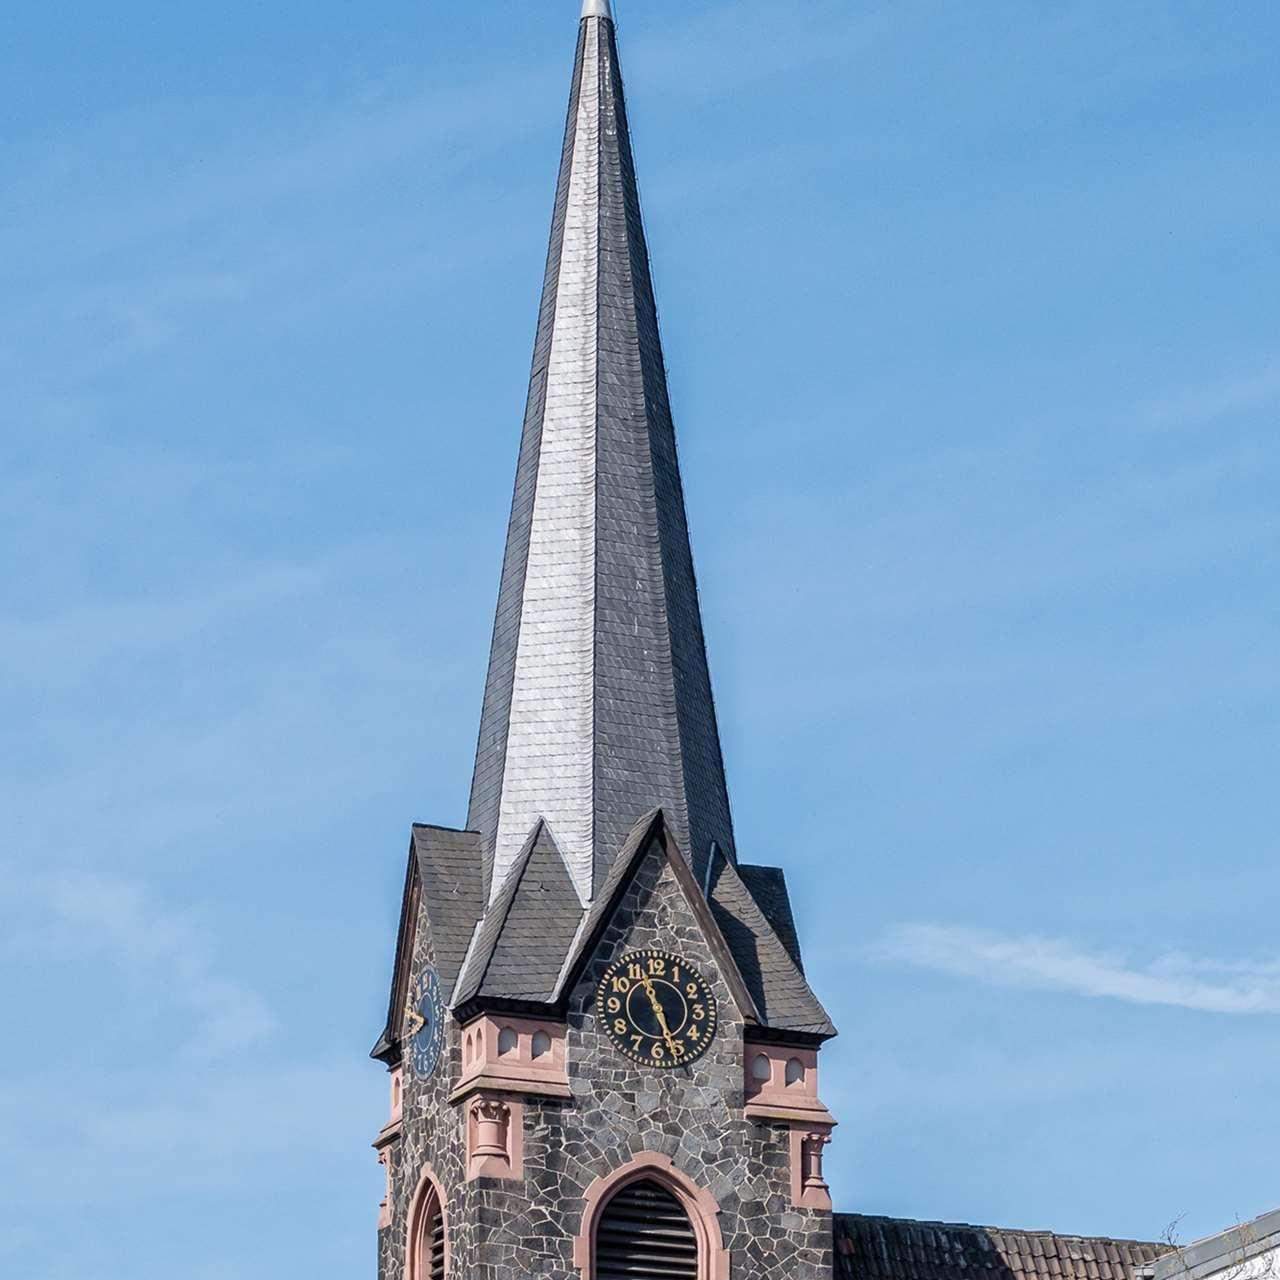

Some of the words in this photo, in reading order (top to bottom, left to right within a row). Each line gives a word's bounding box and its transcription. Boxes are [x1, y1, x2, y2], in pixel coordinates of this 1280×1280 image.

[627, 963, 641, 979] 11
[647, 959, 665, 976] 12
[672, 967, 680, 982] 1
[611, 977, 630, 993] 10
[686, 983, 698, 999] 2
[607, 997, 621, 1013] 9
[692, 1004, 705, 1020] 3
[614, 1018, 627, 1035] 8
[687, 1024, 700, 1041] 4
[631, 1035, 643, 1051] 7
[651, 1042, 664, 1058] 6
